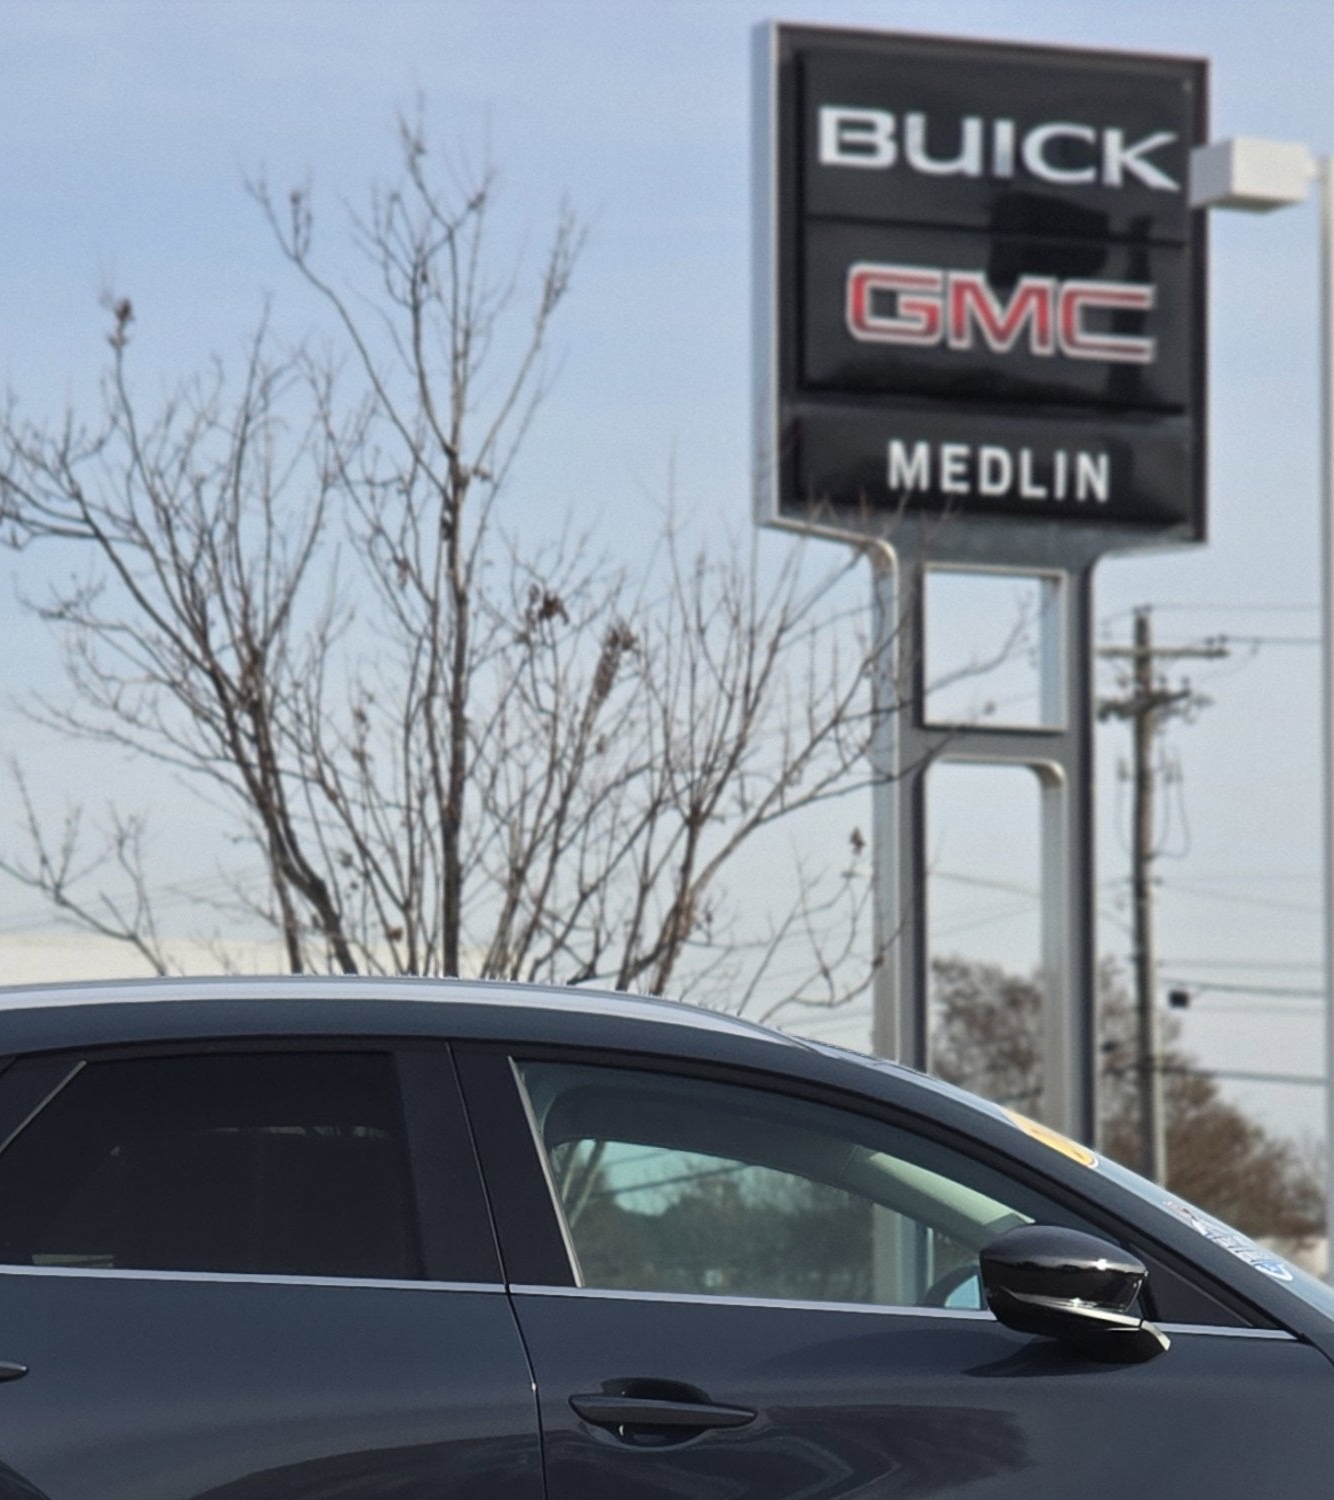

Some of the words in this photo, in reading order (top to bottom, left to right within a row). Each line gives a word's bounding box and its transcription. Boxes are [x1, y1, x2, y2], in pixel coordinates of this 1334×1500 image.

[817, 105, 1181, 193] BUICK
[846, 260, 1155, 364] GMC
[887, 440, 1110, 502] MEDLIN
